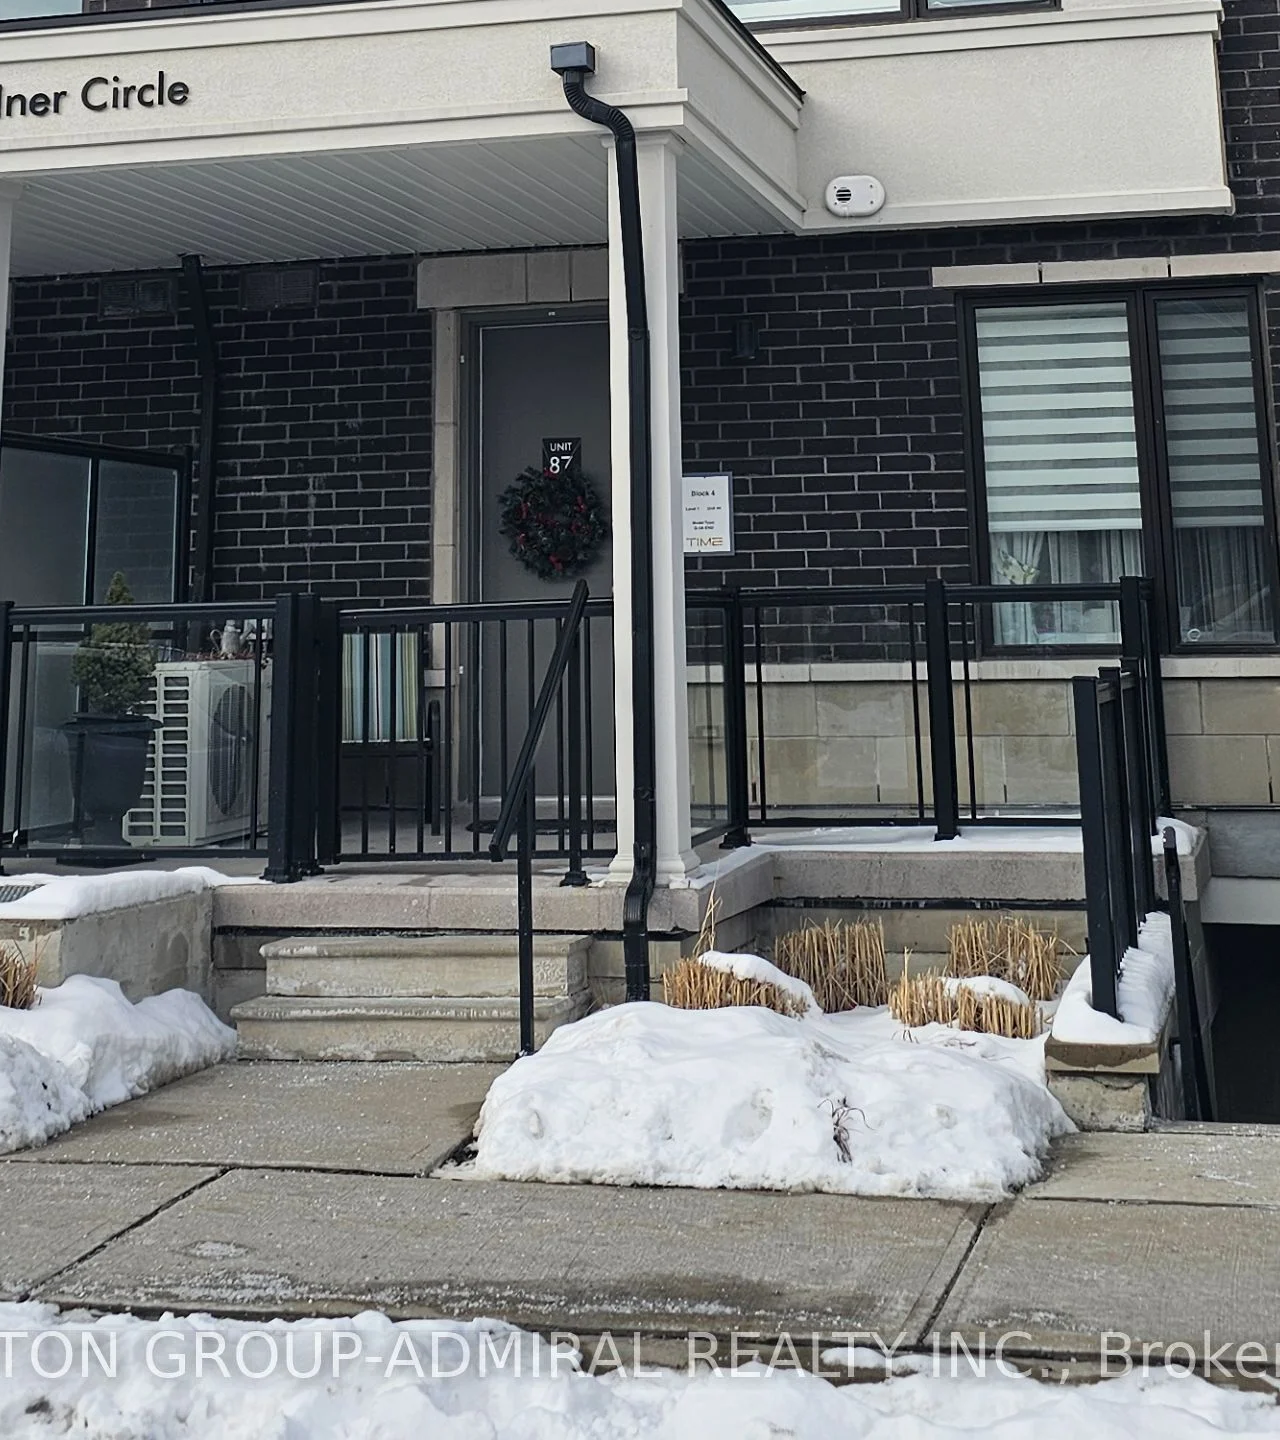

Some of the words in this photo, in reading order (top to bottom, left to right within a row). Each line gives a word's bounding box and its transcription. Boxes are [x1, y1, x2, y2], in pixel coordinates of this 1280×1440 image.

[80, 71, 189, 112] Circle
[550, 441, 572, 451] UNIT
[550, 455, 573, 474] 87
[686, 537, 723, 547] TIME
